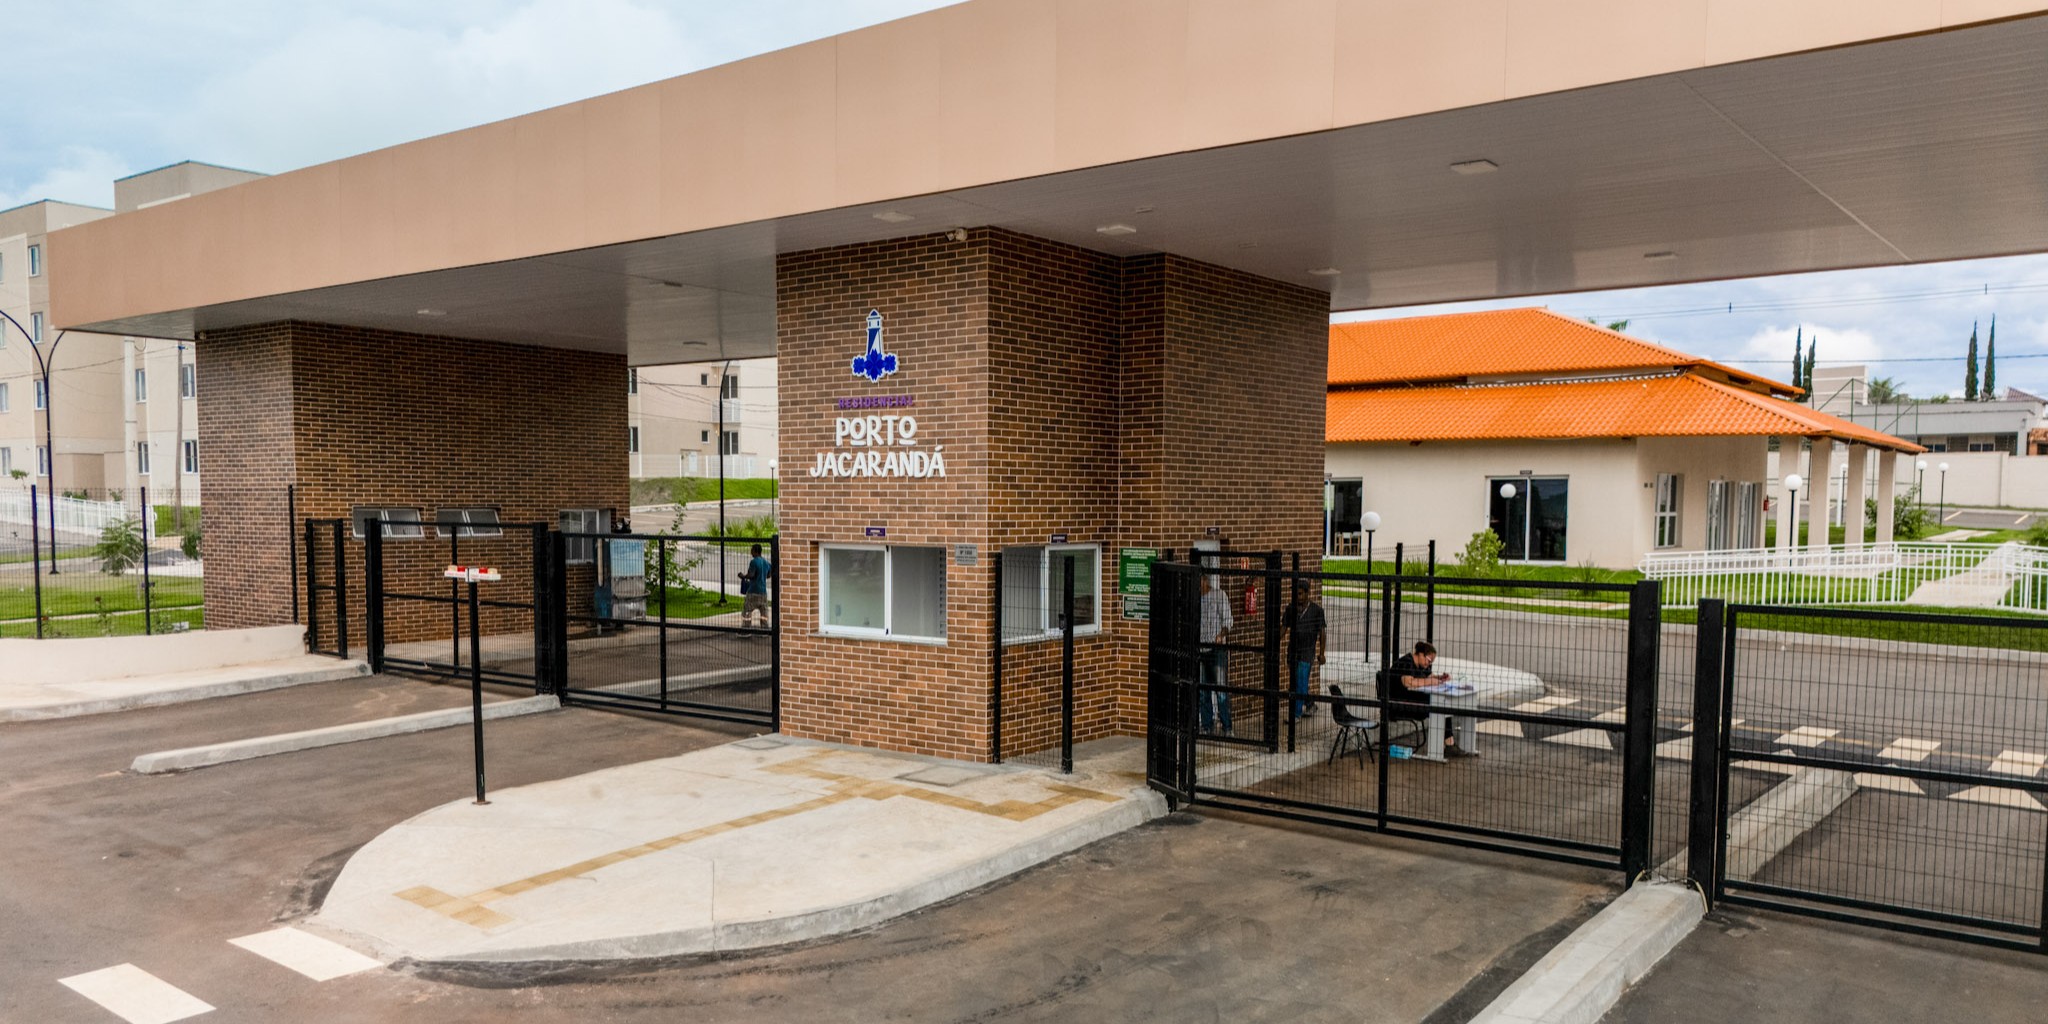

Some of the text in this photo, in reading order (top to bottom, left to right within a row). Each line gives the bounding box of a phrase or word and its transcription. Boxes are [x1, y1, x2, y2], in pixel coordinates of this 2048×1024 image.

[838, 395, 914, 409] RESIDENCIAL
[835, 415, 918, 446] PORTO
[809, 444, 946, 478] JACARANDÁ
